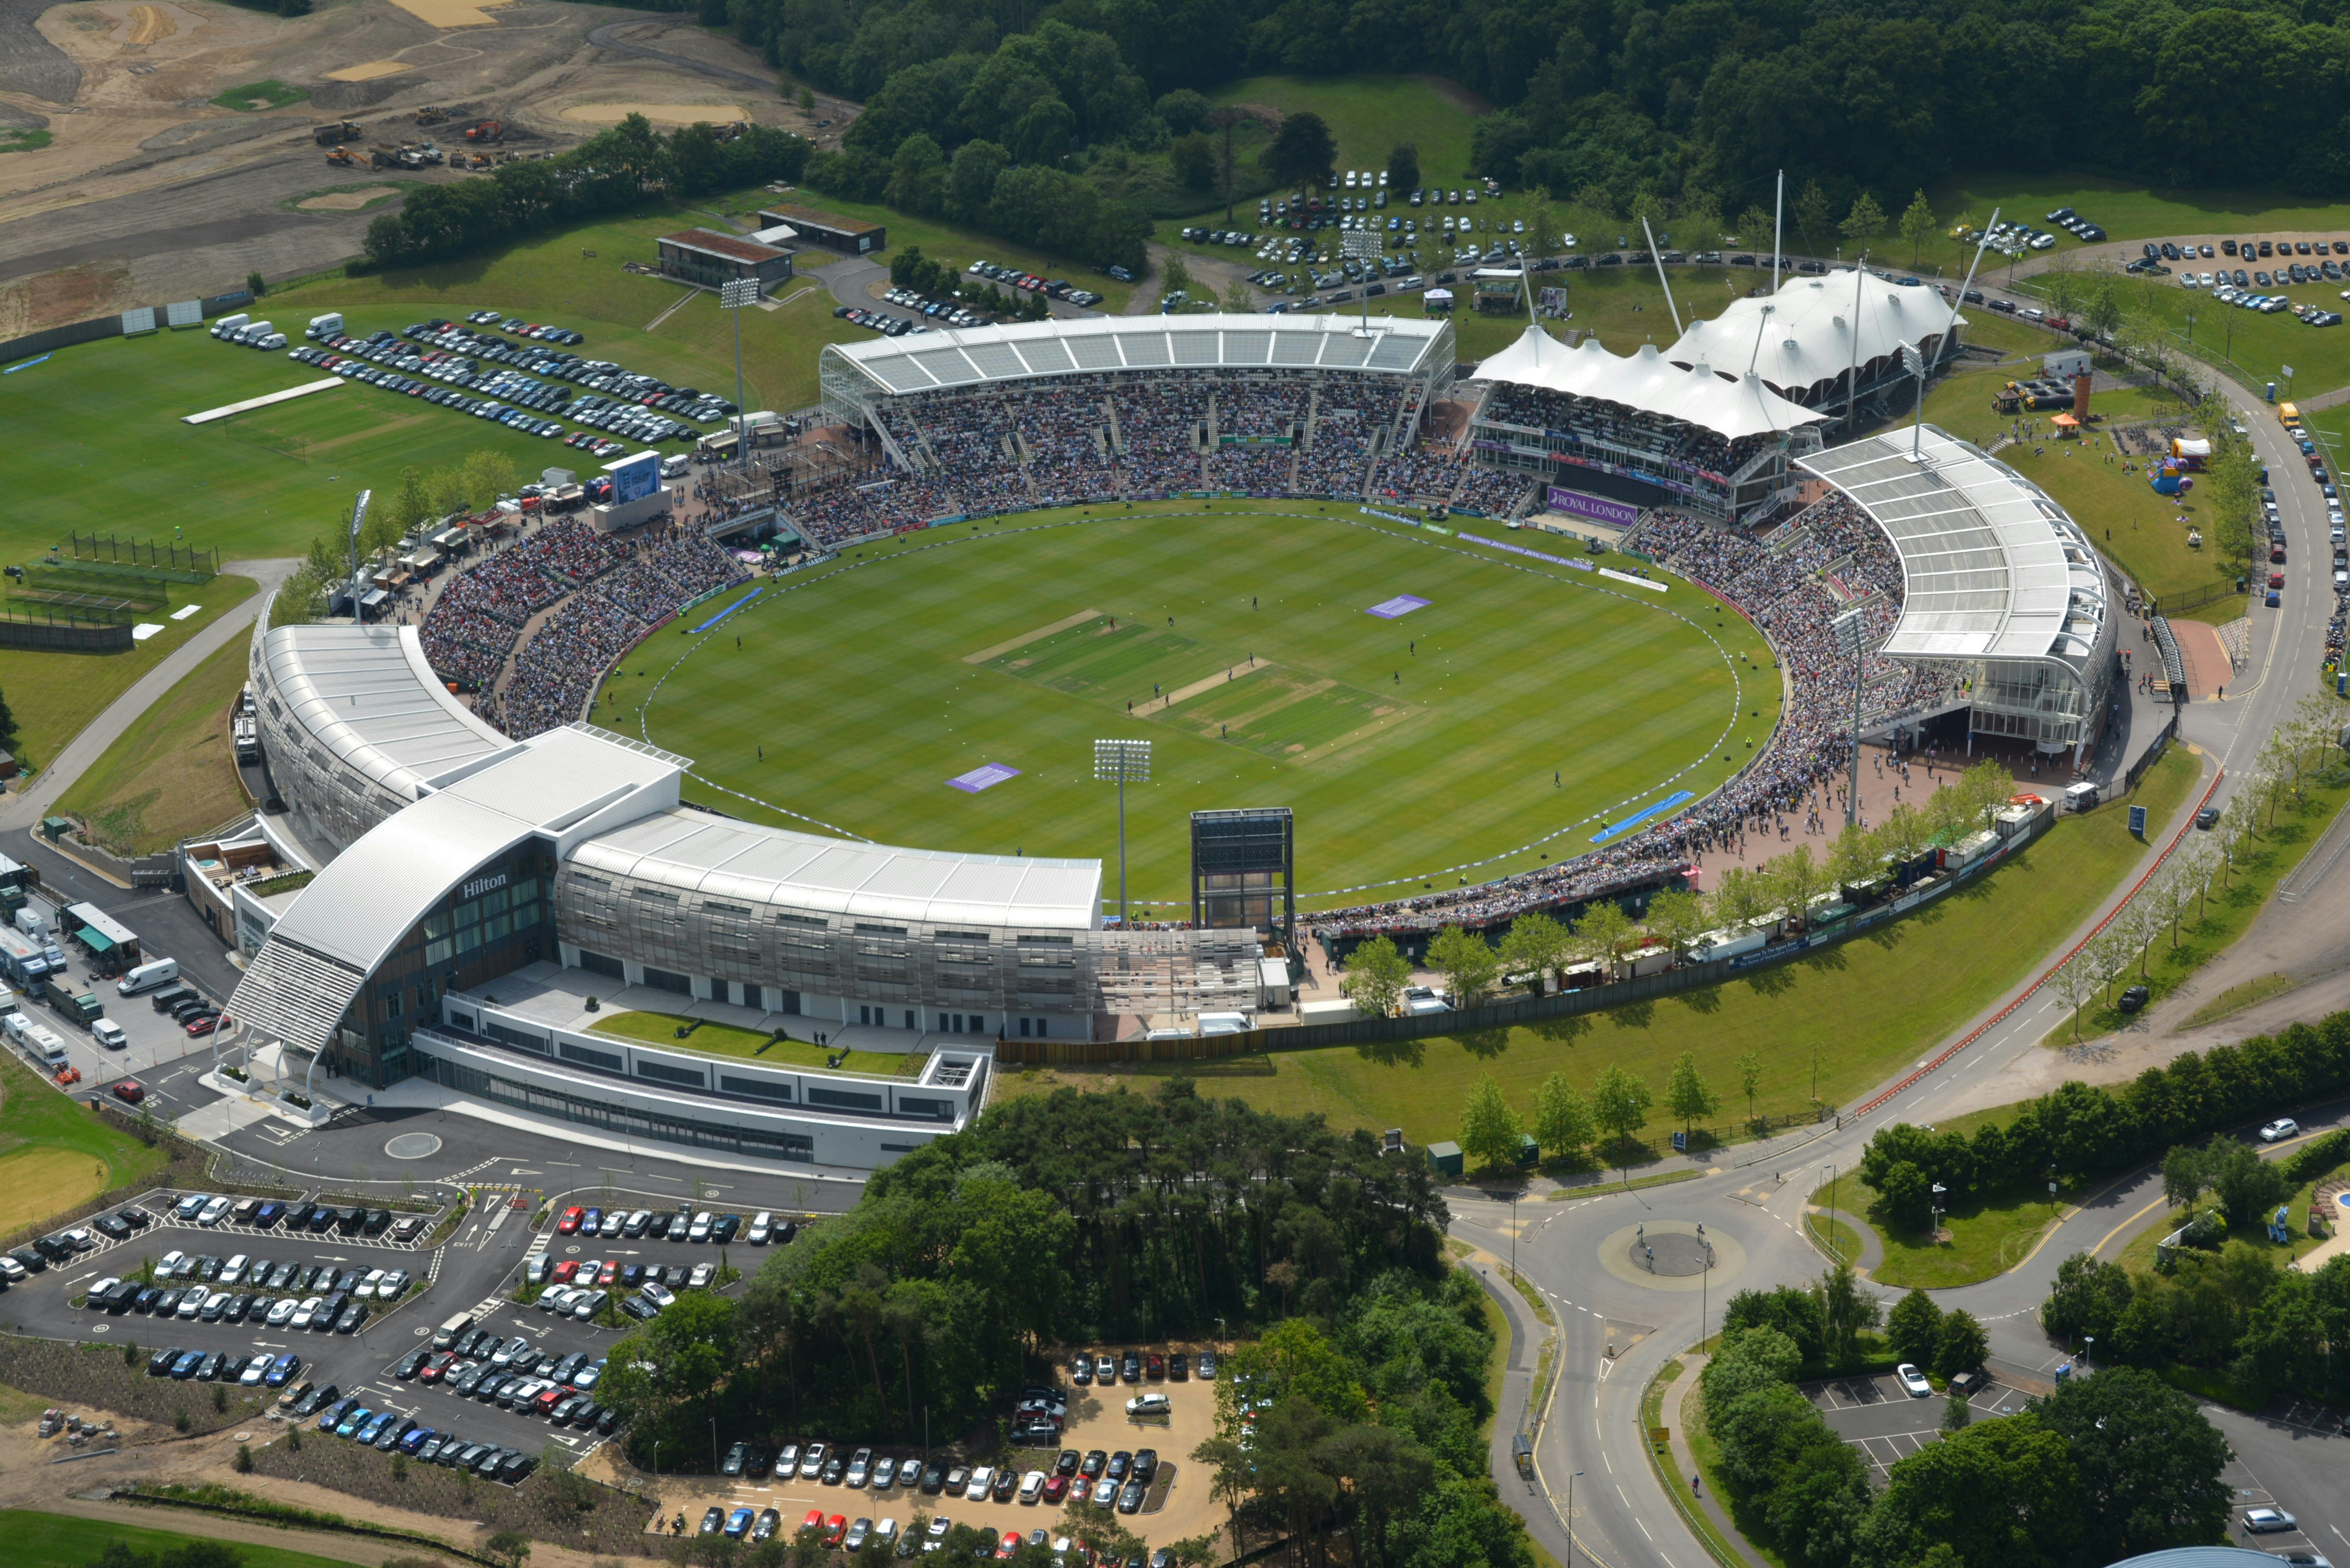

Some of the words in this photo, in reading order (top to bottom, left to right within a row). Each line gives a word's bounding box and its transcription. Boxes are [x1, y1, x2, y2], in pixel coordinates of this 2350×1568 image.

[1369, 509, 1383, 517] Liberty
[1559, 495, 1589, 511] ROYAL
[1591, 503, 1634, 522] LONDON
[748, 511, 767, 521] University
[1426, 524, 1447, 534] Waitrose
[1462, 533, 1474, 541] ROYAL
[1473, 536, 1490, 545] LONDON
[1506, 545, 1524, 553] LONDON
[1527, 550, 1540, 558] ROYAL
[1540, 554, 1558, 562] LONDON
[1574, 562, 1592, 571] LONDON
[1612, 572, 1629, 581] TOYOTA
[1644, 581, 1662, 590] TOYOTA
[464, 873, 506, 899] Hilton
[1743, 952, 1761, 961] Welcome
[1765, 950, 1785, 961] Hampshire
[179, 1064, 200, 1073] EXIT
[147, 1099, 163, 1108] OFF
[535, 1327, 553, 1338] EXIT
[403, 1406, 421, 1418] EXIT
[771, 1500, 782, 1510] XIT
